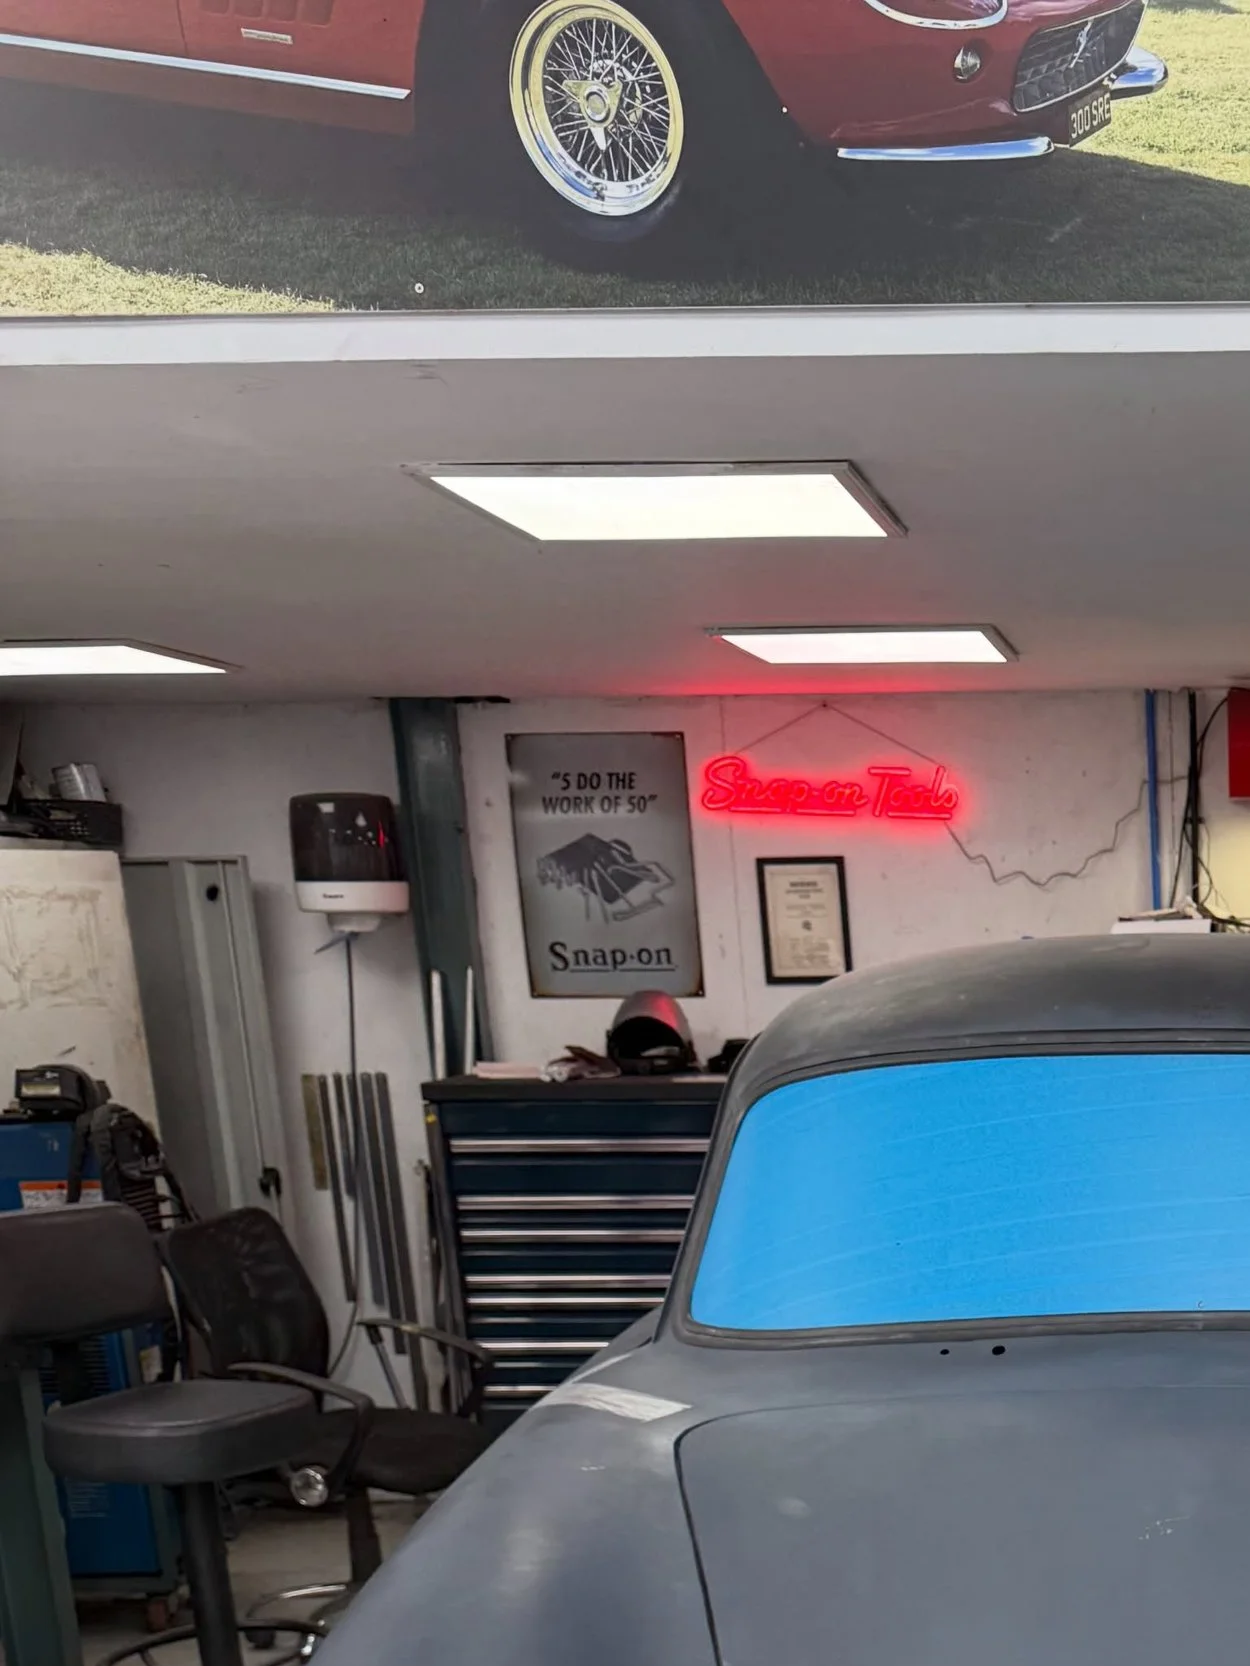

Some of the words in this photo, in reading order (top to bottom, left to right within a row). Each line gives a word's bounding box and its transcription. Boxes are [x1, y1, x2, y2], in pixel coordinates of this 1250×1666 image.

[1070, 105, 1091, 139] 300
[1091, 92, 1111, 127] SRE
[576, 772, 601, 790] DO
[606, 772, 637, 790] THE
[702, 756, 868, 813] Snap-on
[867, 765, 959, 818] Tools
[542, 796, 595, 814] WORK
[600, 796, 622, 813] OF
